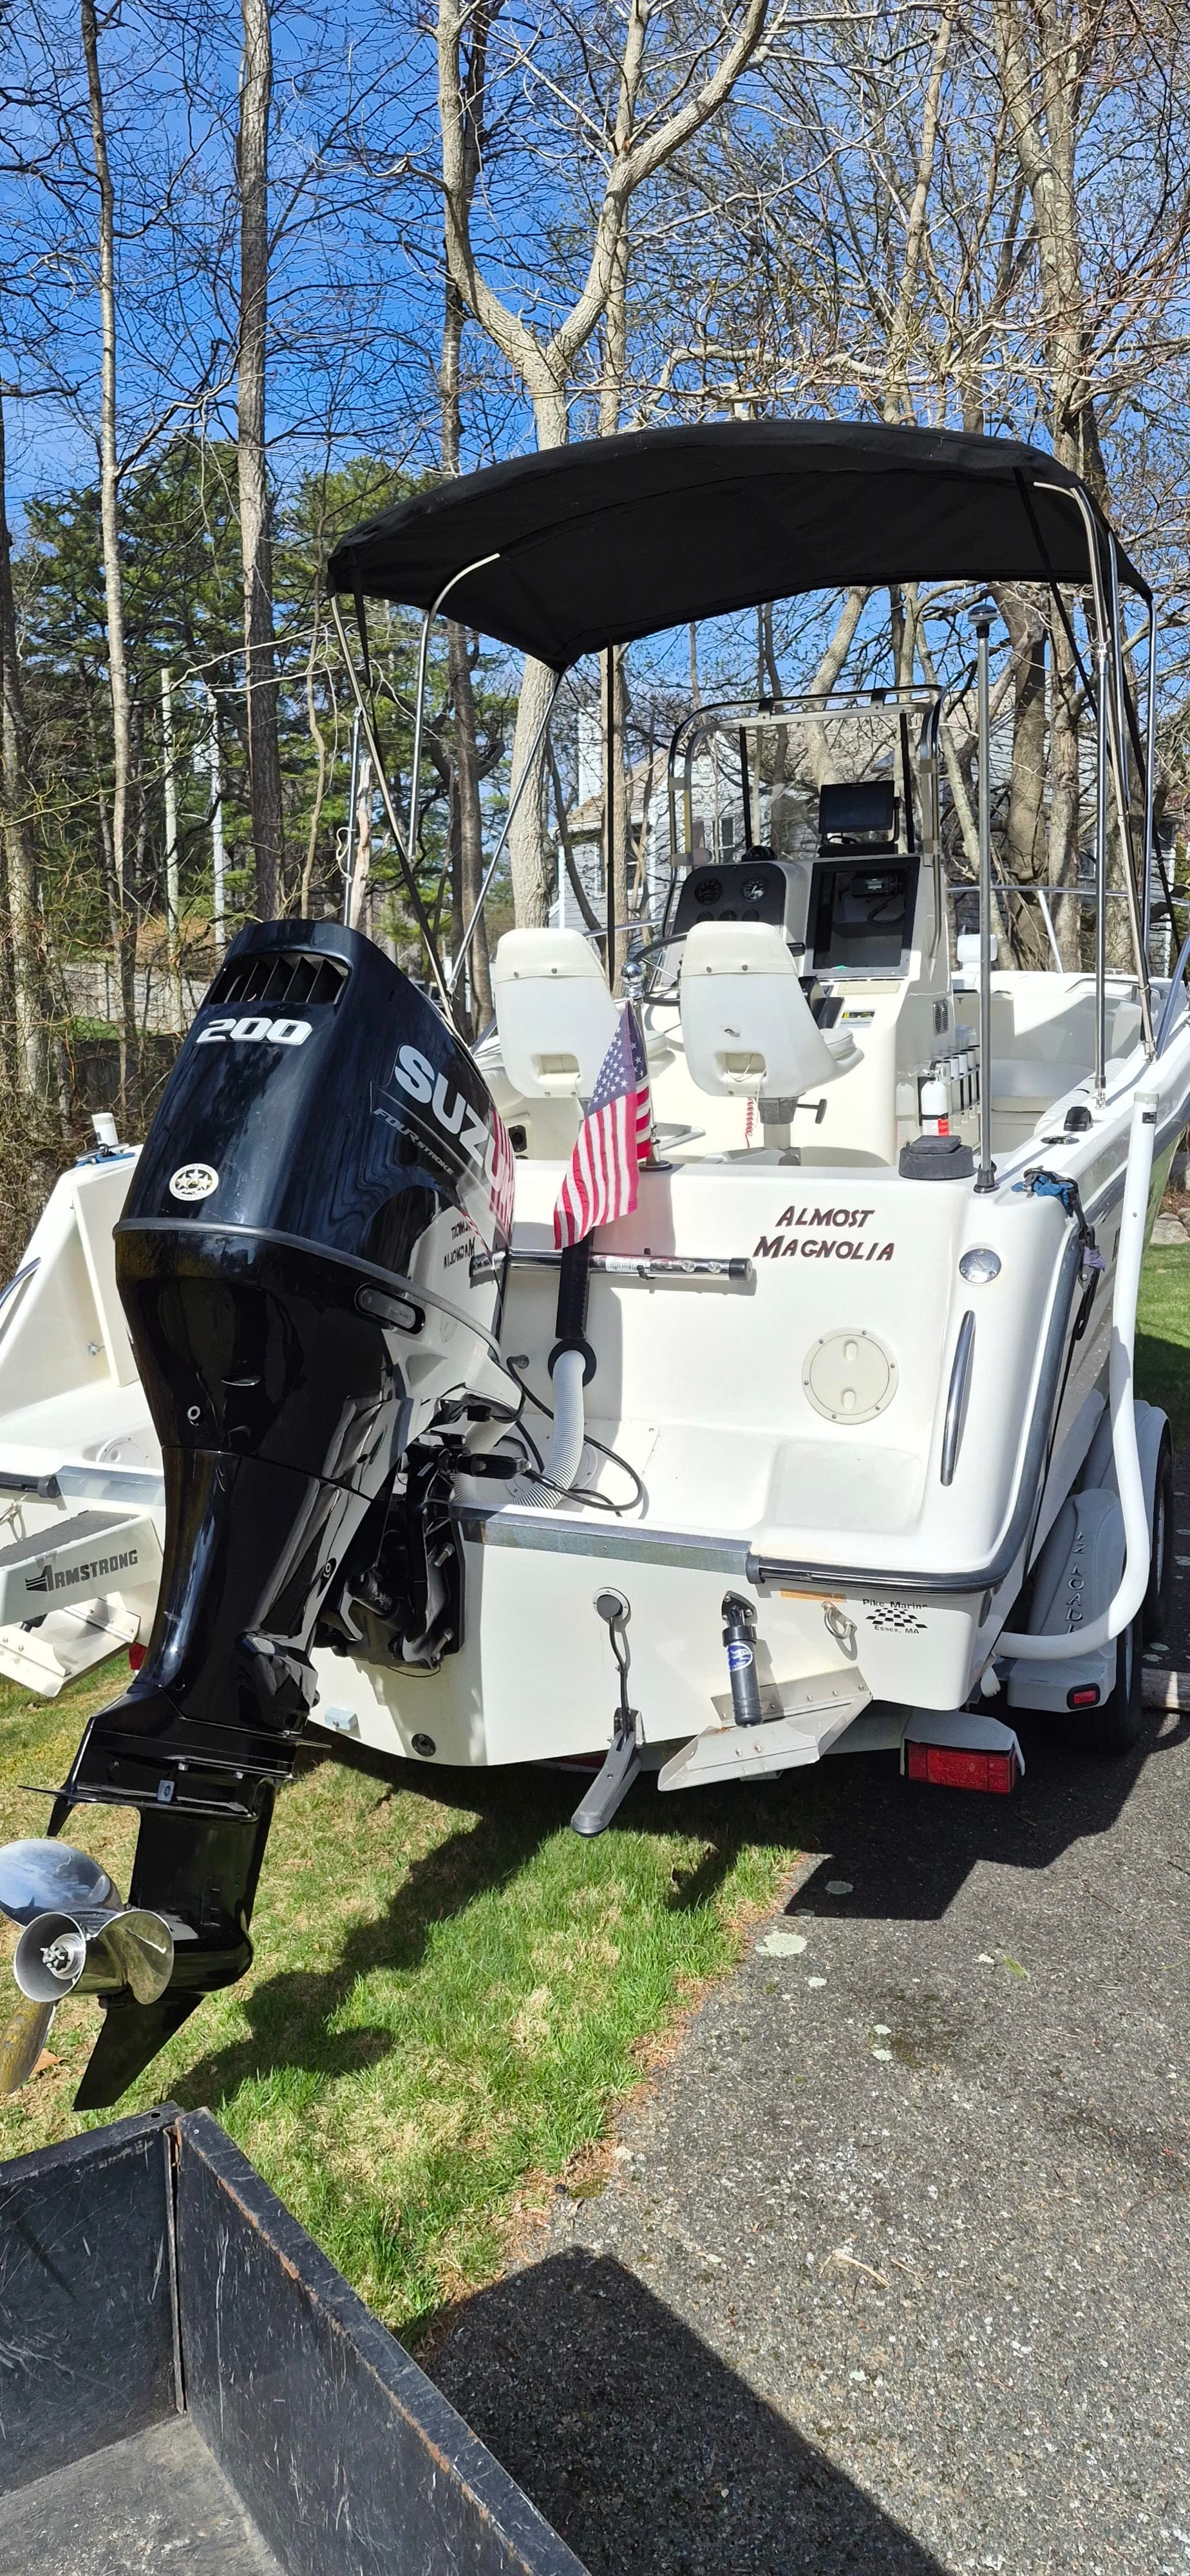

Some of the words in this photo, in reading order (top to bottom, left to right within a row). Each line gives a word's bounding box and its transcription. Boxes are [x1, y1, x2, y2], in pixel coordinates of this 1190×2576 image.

[196, 1017, 313, 1046] 200
[373, 1107, 420, 1143] FOUR
[417, 1141, 454, 1175] STROKE
[775, 1205, 876, 1229] ALMOST
[751, 1235, 894, 1262] MAGNOLIA
[25, 1549, 138, 1592] ARMSTRONG
[863, 1598, 885, 1607] Pike
[874, 1625, 902, 1634] Essex,
